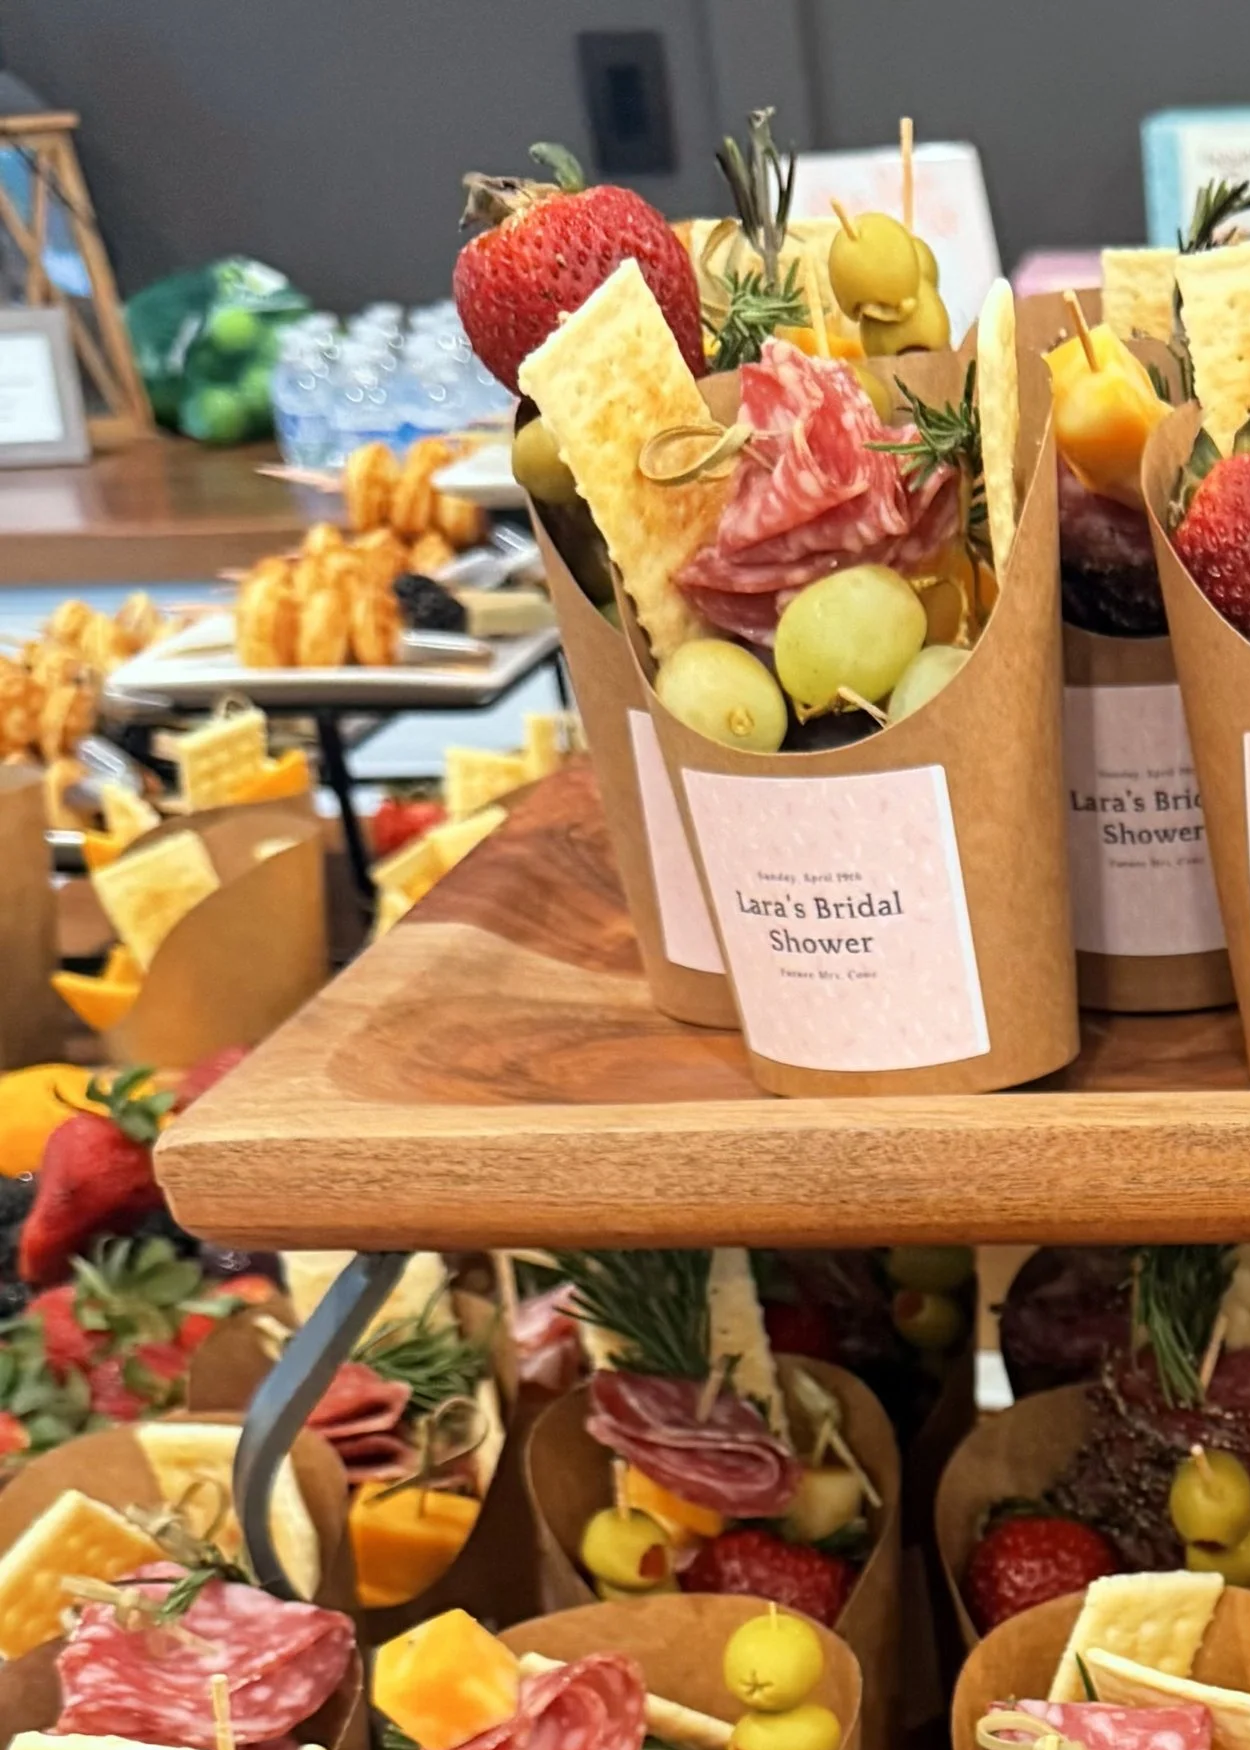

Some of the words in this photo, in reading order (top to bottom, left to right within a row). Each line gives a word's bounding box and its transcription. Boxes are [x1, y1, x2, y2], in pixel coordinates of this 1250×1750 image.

[1069, 788, 1145, 813] Lara's
[1154, 787, 1203, 812] Bri
[1103, 822, 1205, 845] Shower
[736, 889, 807, 919] Lara's
[813, 889, 904, 919] Bridal
[769, 928, 874, 954] Shower
